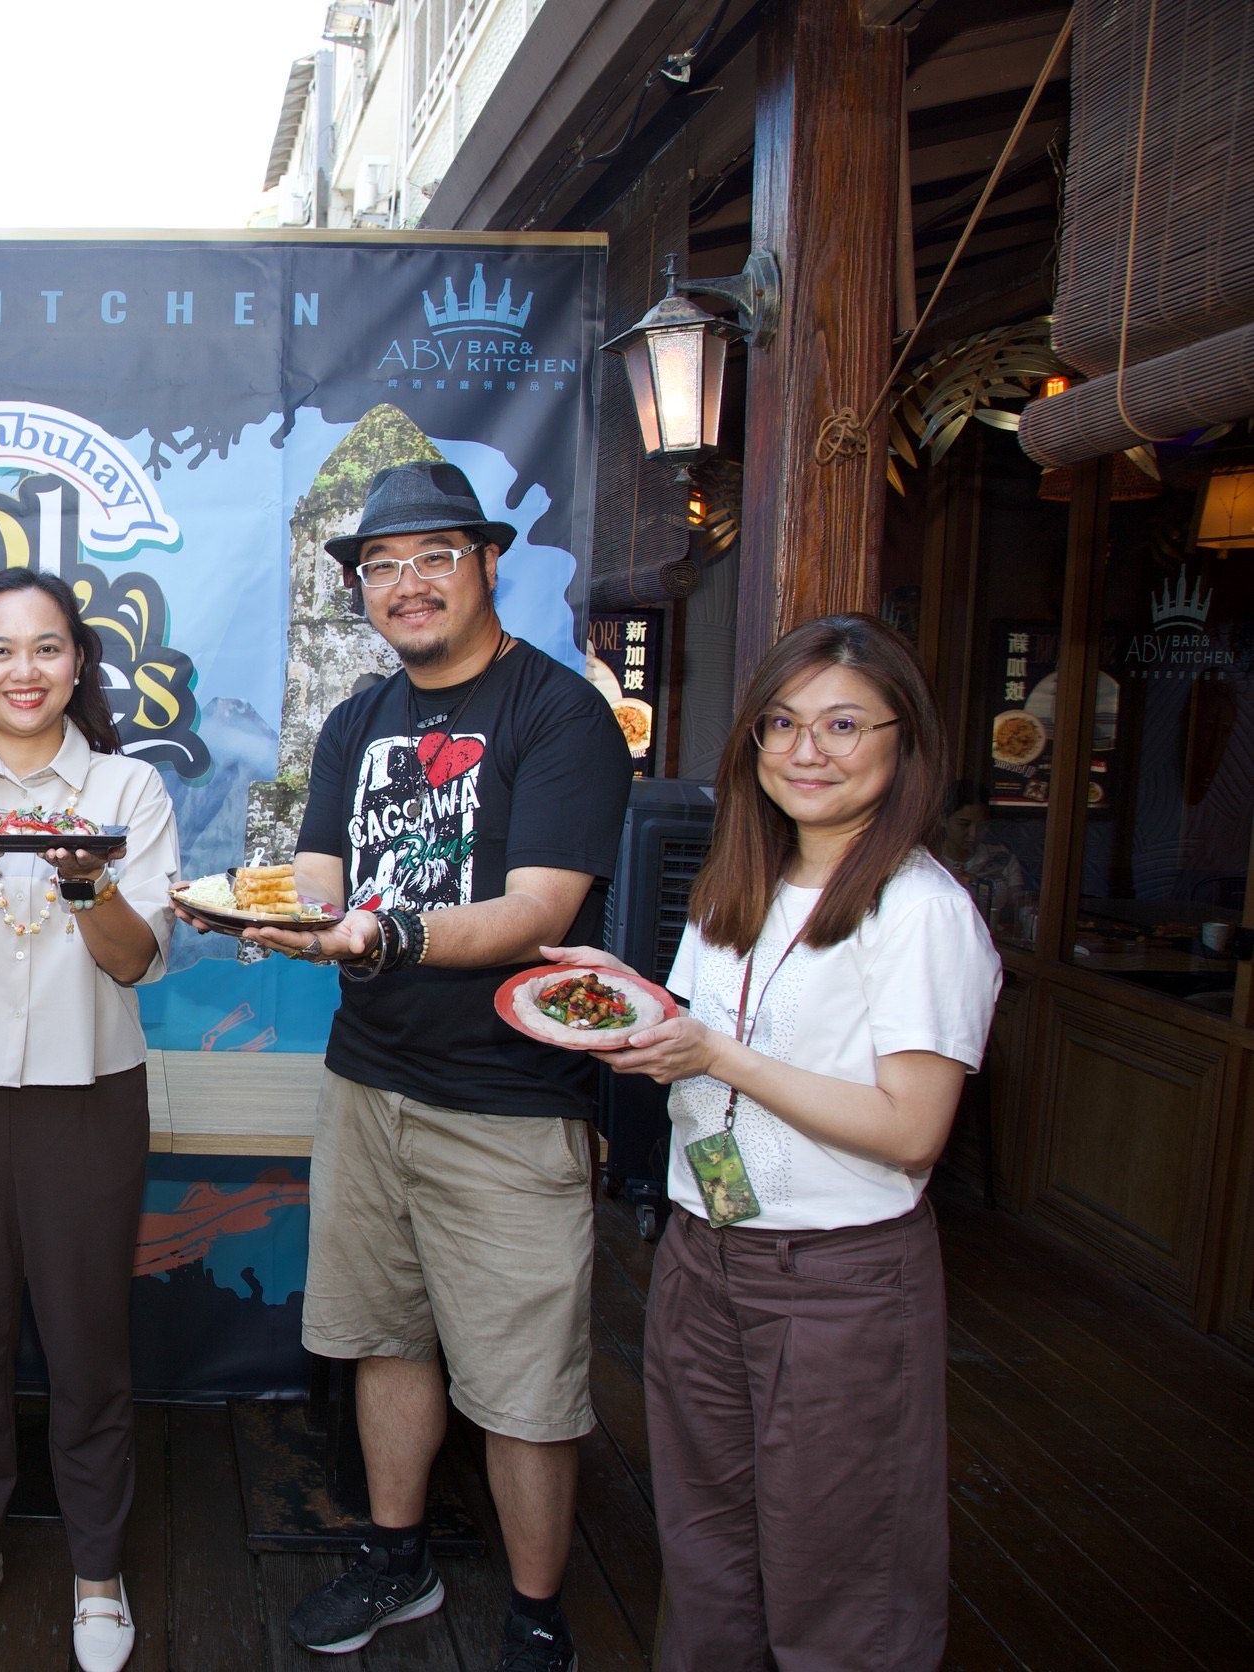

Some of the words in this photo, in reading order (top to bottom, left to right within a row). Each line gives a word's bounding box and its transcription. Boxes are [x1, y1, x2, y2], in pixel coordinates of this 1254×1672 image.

[377, 339, 463, 371] ABV
[468, 340, 534, 355] BAR&
[468, 359, 577, 373] KITCHEN
[624, 621, 648, 691] 新加坡
[1125, 634, 1170, 663] ABV
[1172, 635, 1211, 647] BAR&
[1170, 651, 1235, 664] KITCHEN
[368, 739, 395, 791] I
